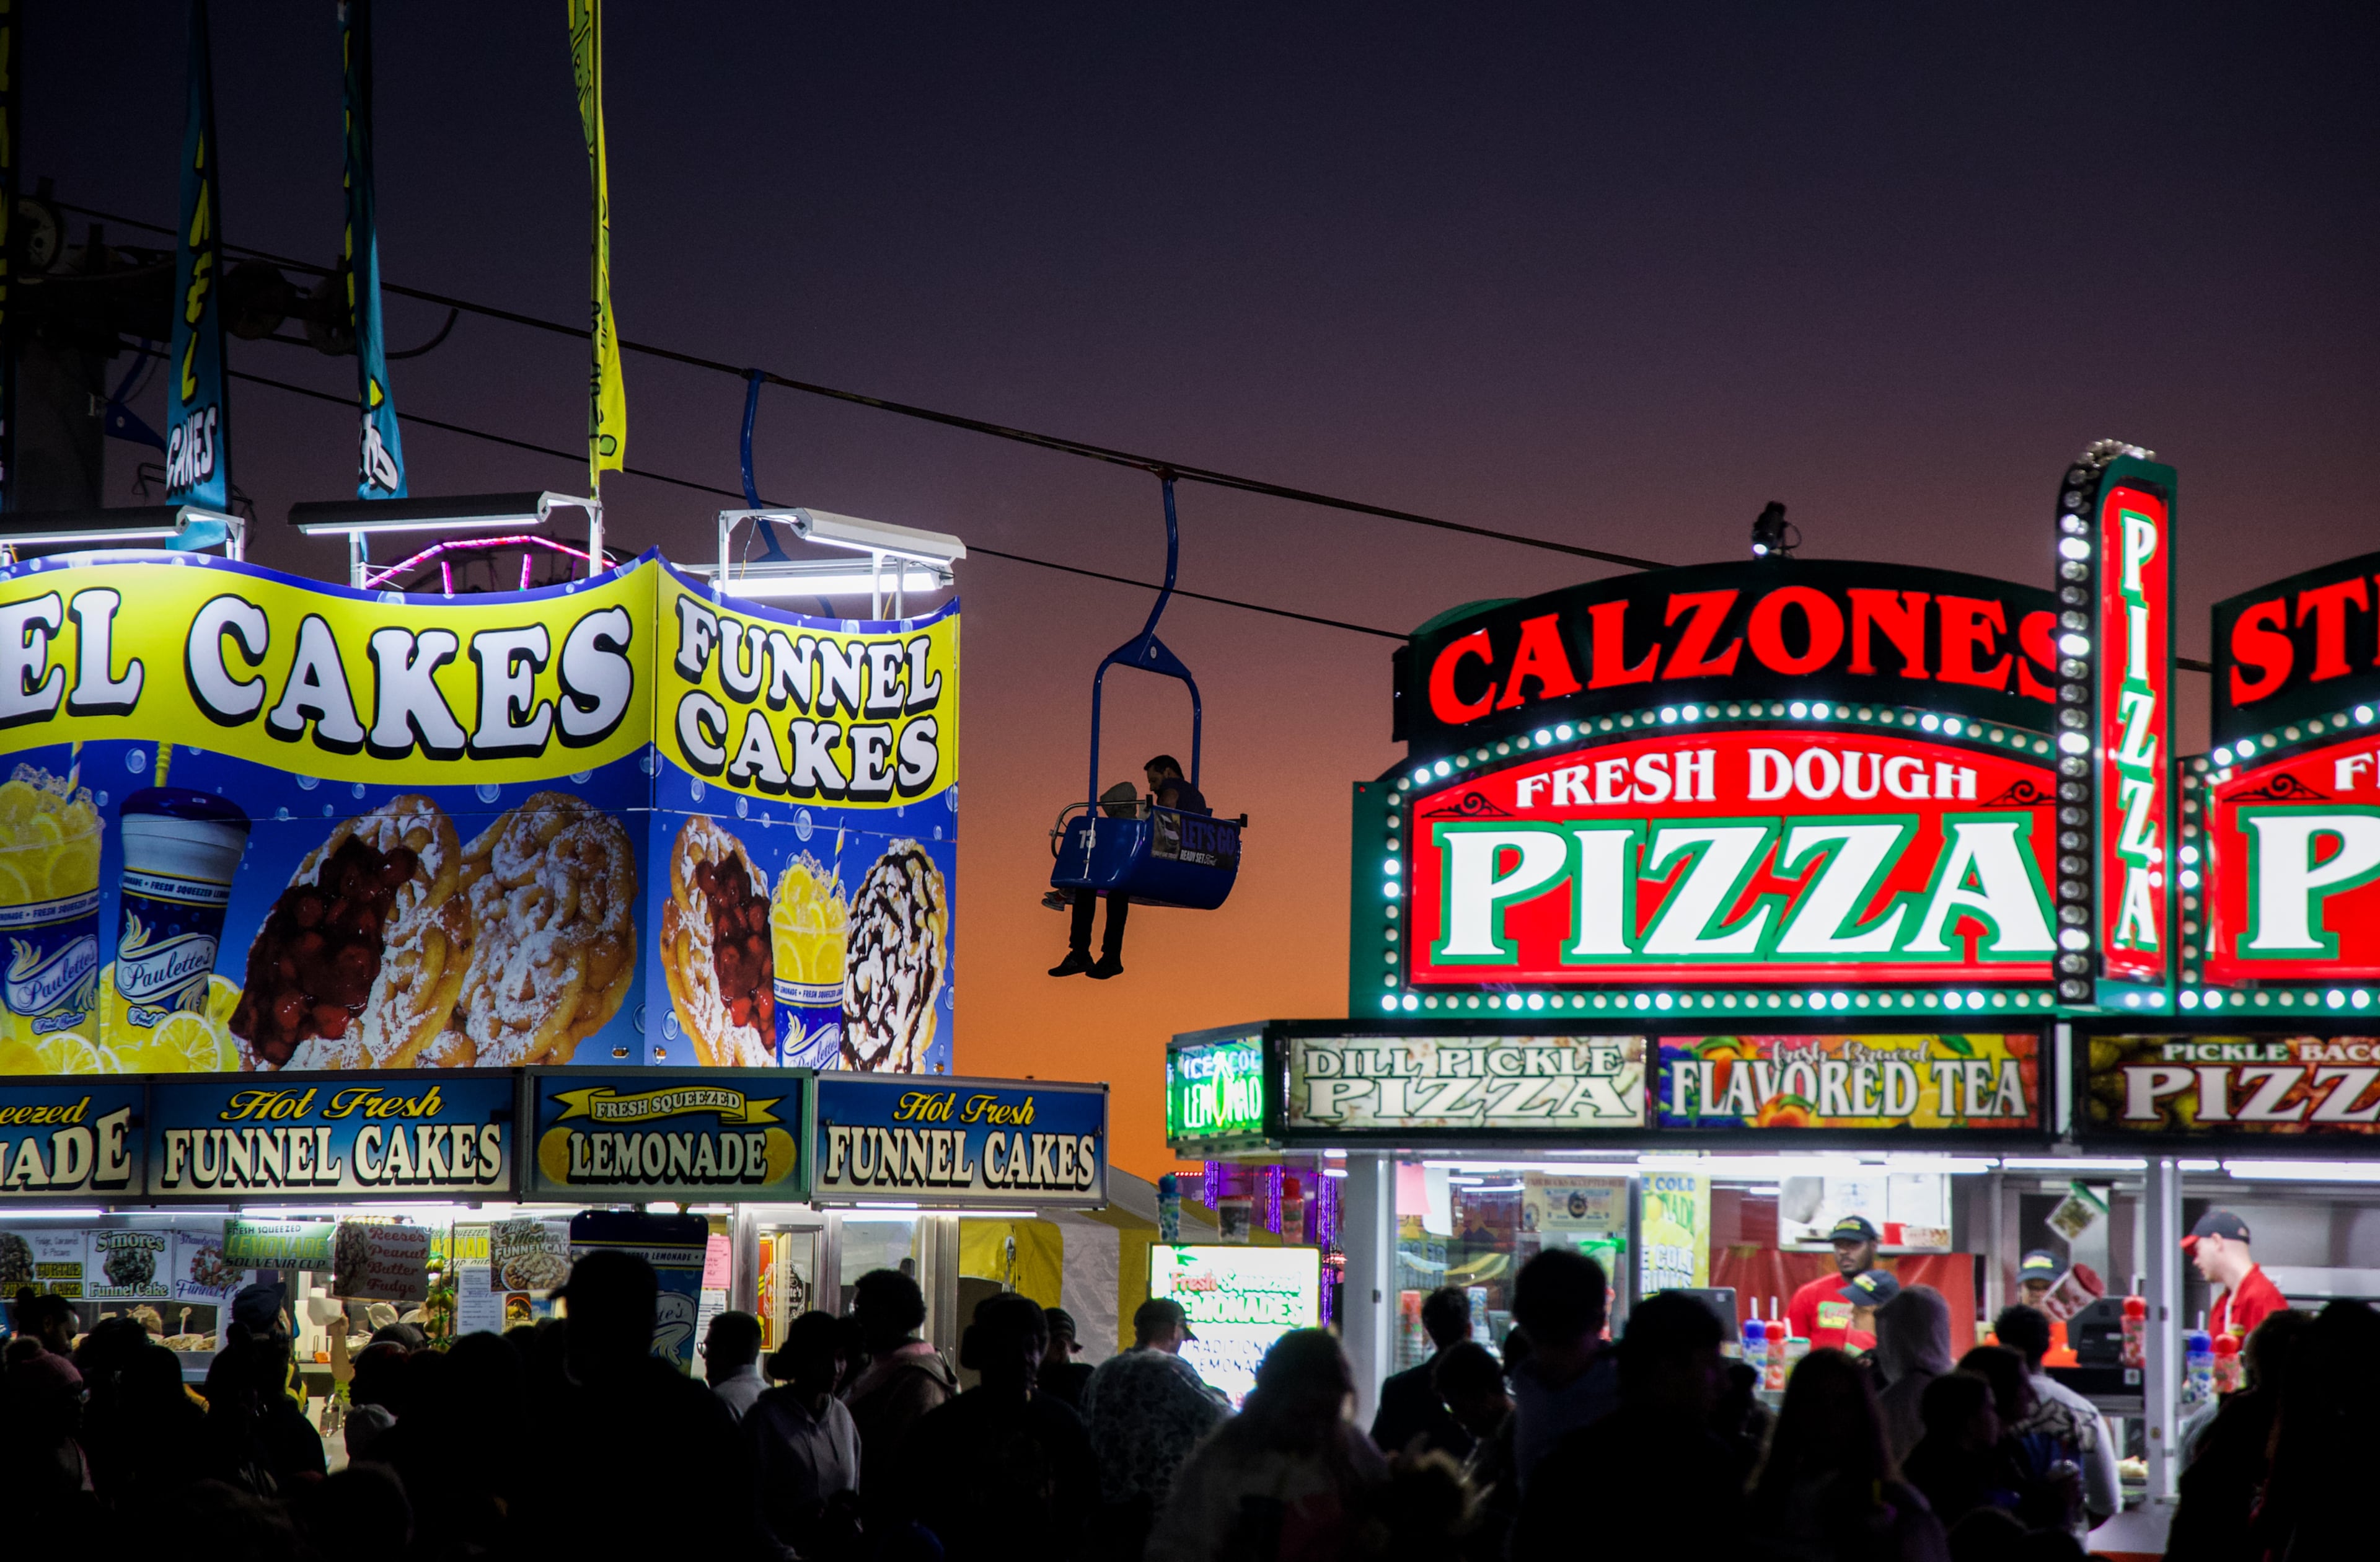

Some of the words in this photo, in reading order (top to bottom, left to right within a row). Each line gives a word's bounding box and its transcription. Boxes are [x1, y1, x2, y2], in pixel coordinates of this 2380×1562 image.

[166, 405, 217, 493] CAKES
[675, 593, 941, 720] FUNNEL
[1429, 585, 2056, 725] CALZONES
[2229, 574, 2380, 707] ST
[185, 593, 633, 761] CAKES
[675, 689, 938, 801] CAKES
[2117, 510, 2159, 948] PIZZA
[1516, 748, 1716, 808] FRESH
[1748, 748, 1977, 800] DOUGH
[1180, 818, 1215, 852] LET'S
[1217, 824, 1236, 856] GO
[1180, 849, 1196, 862] READY
[1196, 852, 1205, 864] SET
[150, 881, 175, 893] FRESH
[177, 885, 213, 898] SQUEEZED
[1432, 813, 2056, 963] PIZZA
[123, 946, 211, 991] Paulette's
[1184, 1054, 1216, 1079] ICE
[1305, 1048, 1421, 1078] DILL
[1437, 1044, 1625, 1078] PICKLE
[2162, 1043, 2290, 1063] PICKLE
[221, 1088, 315, 1121] Hot
[324, 1085, 445, 1119] Fresh
[596, 1096, 649, 1118] FRESH
[651, 1091, 741, 1114] SQUEEZED
[1303, 1076, 1636, 1118] PIZZA
[1673, 1059, 1919, 1117] FLAVORED
[1933, 1059, 2028, 1117] TEA
[2120, 1065, 2380, 1122] PIZZ
[892, 1091, 958, 1124] Hot
[959, 1094, 1037, 1126] Fresh
[162, 1127, 342, 1188] FUNNEL
[353, 1123, 503, 1186] CAKES
[568, 1130, 768, 1185] LEMONADE
[823, 1126, 974, 1188] FUNNEL
[982, 1128, 1095, 1191] CAKES
[1655, 1177, 1695, 1191] COLD
[95, 1231, 164, 1252] S'mores
[226, 1235, 325, 1258] LEMONADE
[227, 1227, 255, 1235] FRESH
[258, 1225, 301, 1233] SQUEEZED
[368, 1227, 427, 1243] Reese's
[225, 1258, 296, 1269] SOUVENIR
[299, 1260, 326, 1269] CUP
[368, 1244, 428, 1260] Peanut
[431, 1237, 490, 1259] MONAD
[495, 1243, 543, 1262] FUNNEL
[651, 1252, 692, 1261] LEMONADE
[366, 1261, 419, 1276] Butter
[1170, 1269, 1218, 1293] Fresh
[89, 1282, 133, 1297] Funnel
[135, 1280, 169, 1297] Cake
[176, 1279, 222, 1299] Funnel
[366, 1277, 417, 1297] Fudge
[1176, 1293, 1303, 1328] EMONADES
